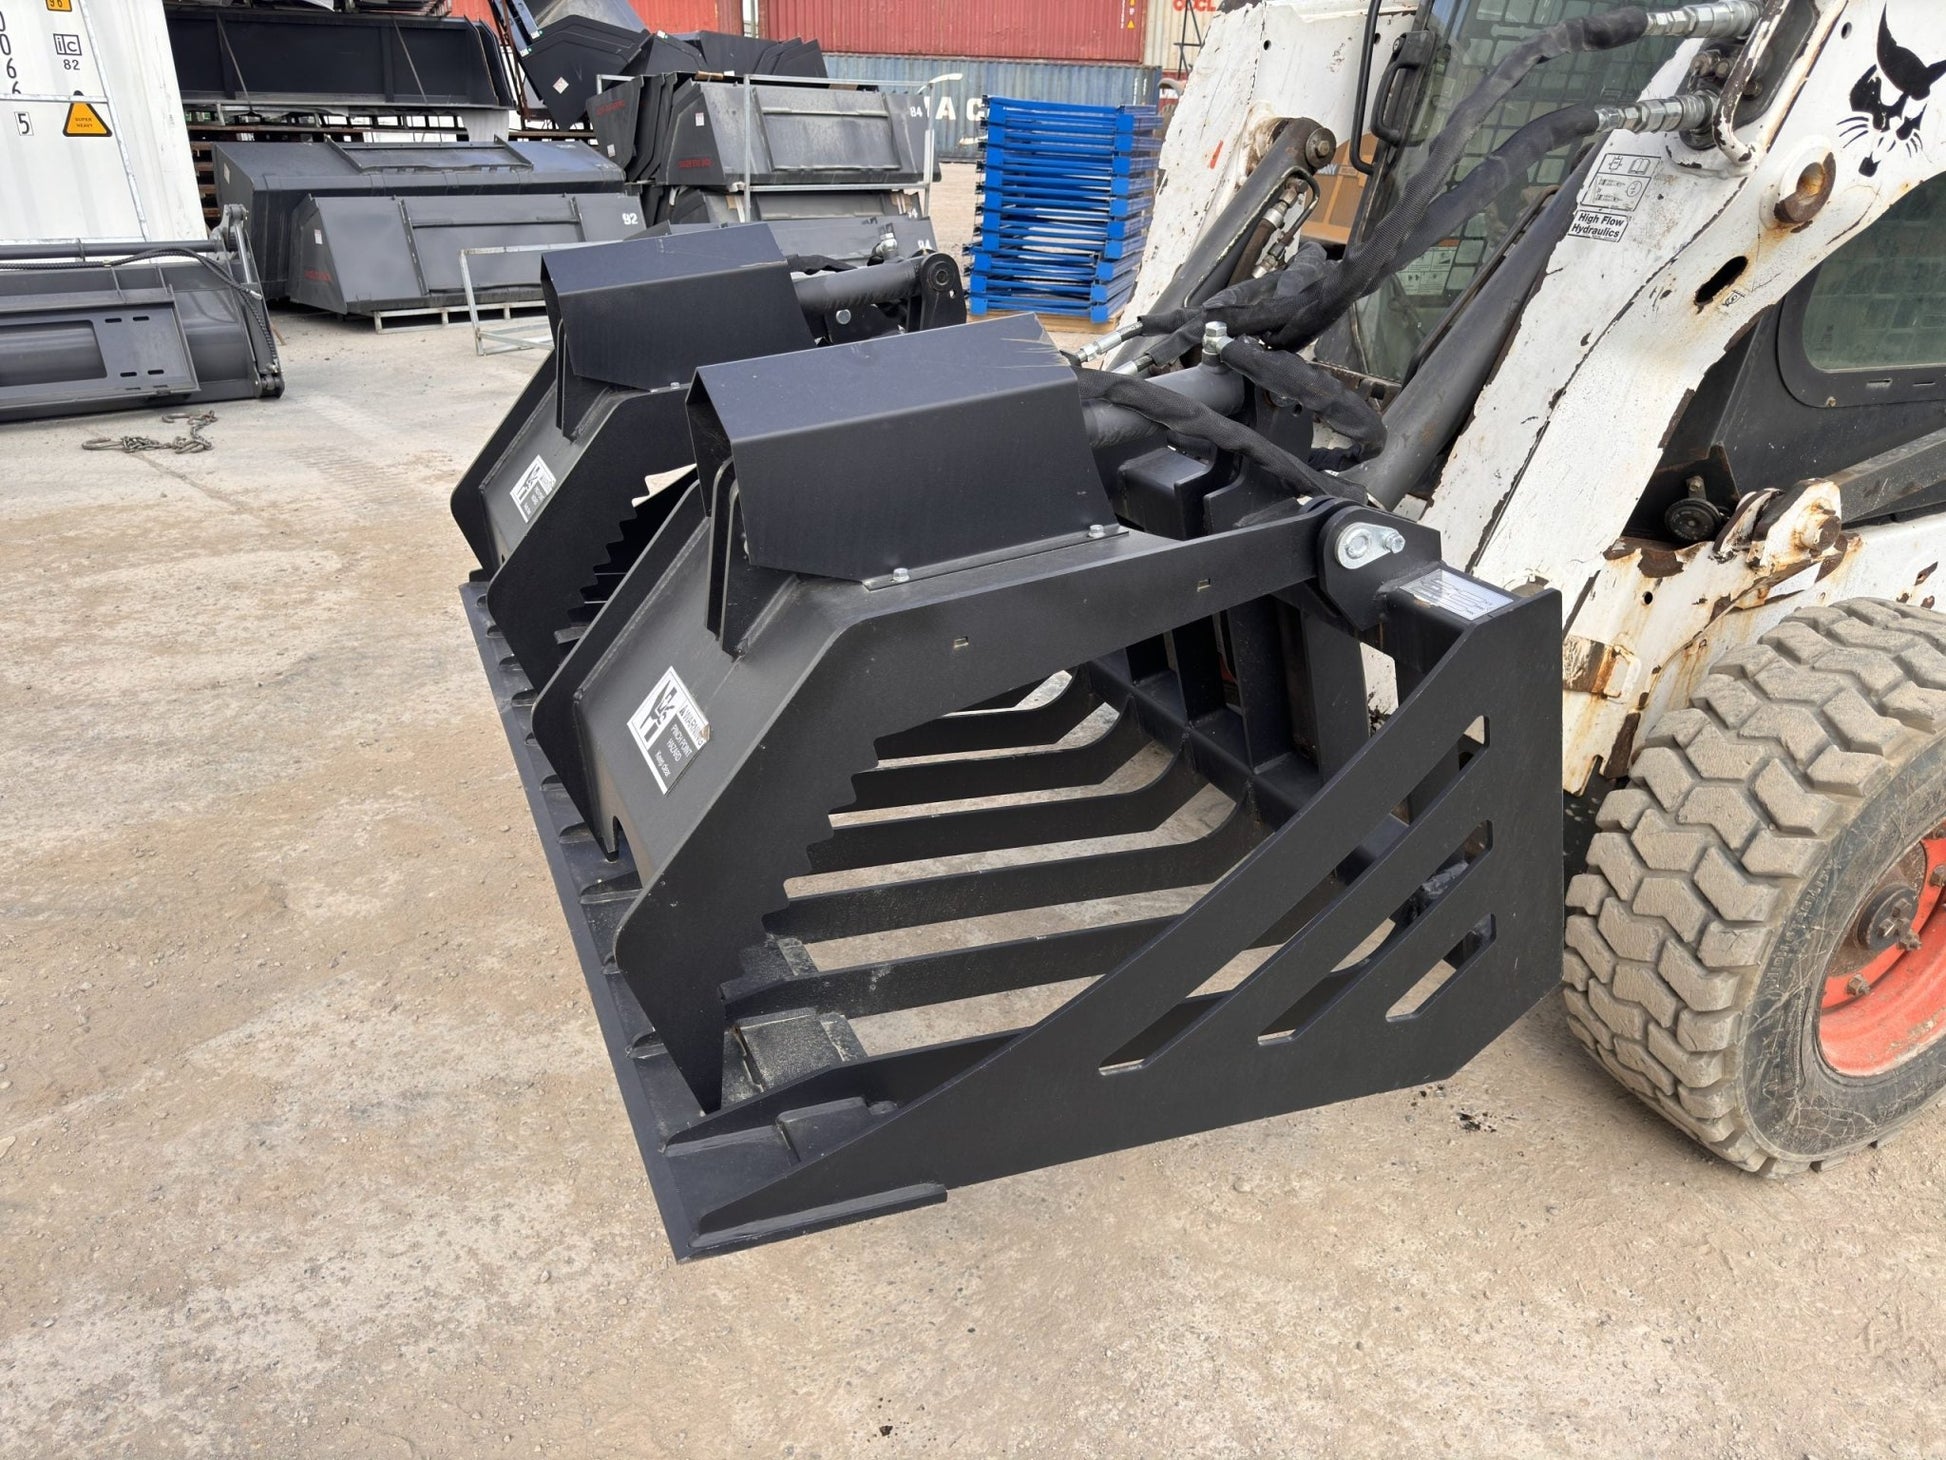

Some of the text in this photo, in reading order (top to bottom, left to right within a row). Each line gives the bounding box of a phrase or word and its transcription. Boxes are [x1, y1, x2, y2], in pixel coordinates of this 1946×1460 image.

[63, 59, 81, 71] 82
[910, 106, 923, 118] 84
[1578, 213, 1625, 227] High Flow
[1571, 223, 1620, 238] Hydraulics
